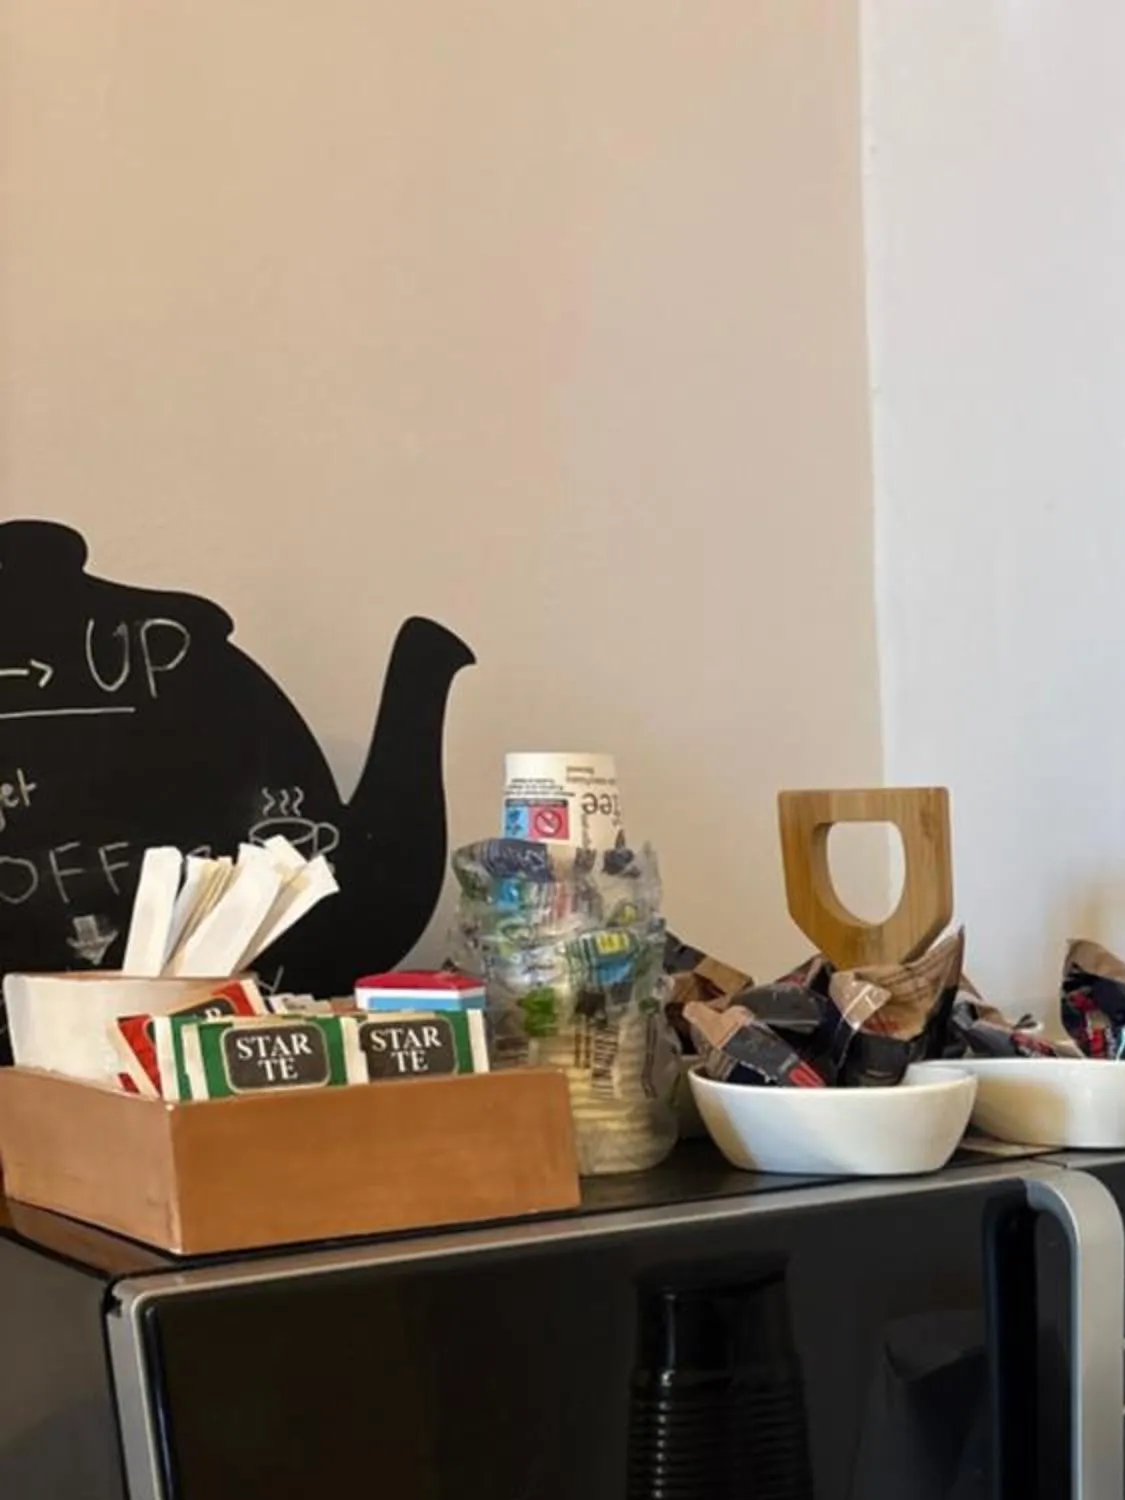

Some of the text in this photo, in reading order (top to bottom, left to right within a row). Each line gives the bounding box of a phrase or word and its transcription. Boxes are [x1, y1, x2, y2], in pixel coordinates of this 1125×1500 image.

[85, 618, 191, 699] UP
[235, 1032, 313, 1061] STAR
[370, 1025, 443, 1053] STAR
[256, 1056, 299, 1082] TE
[390, 1048, 429, 1074] TE
